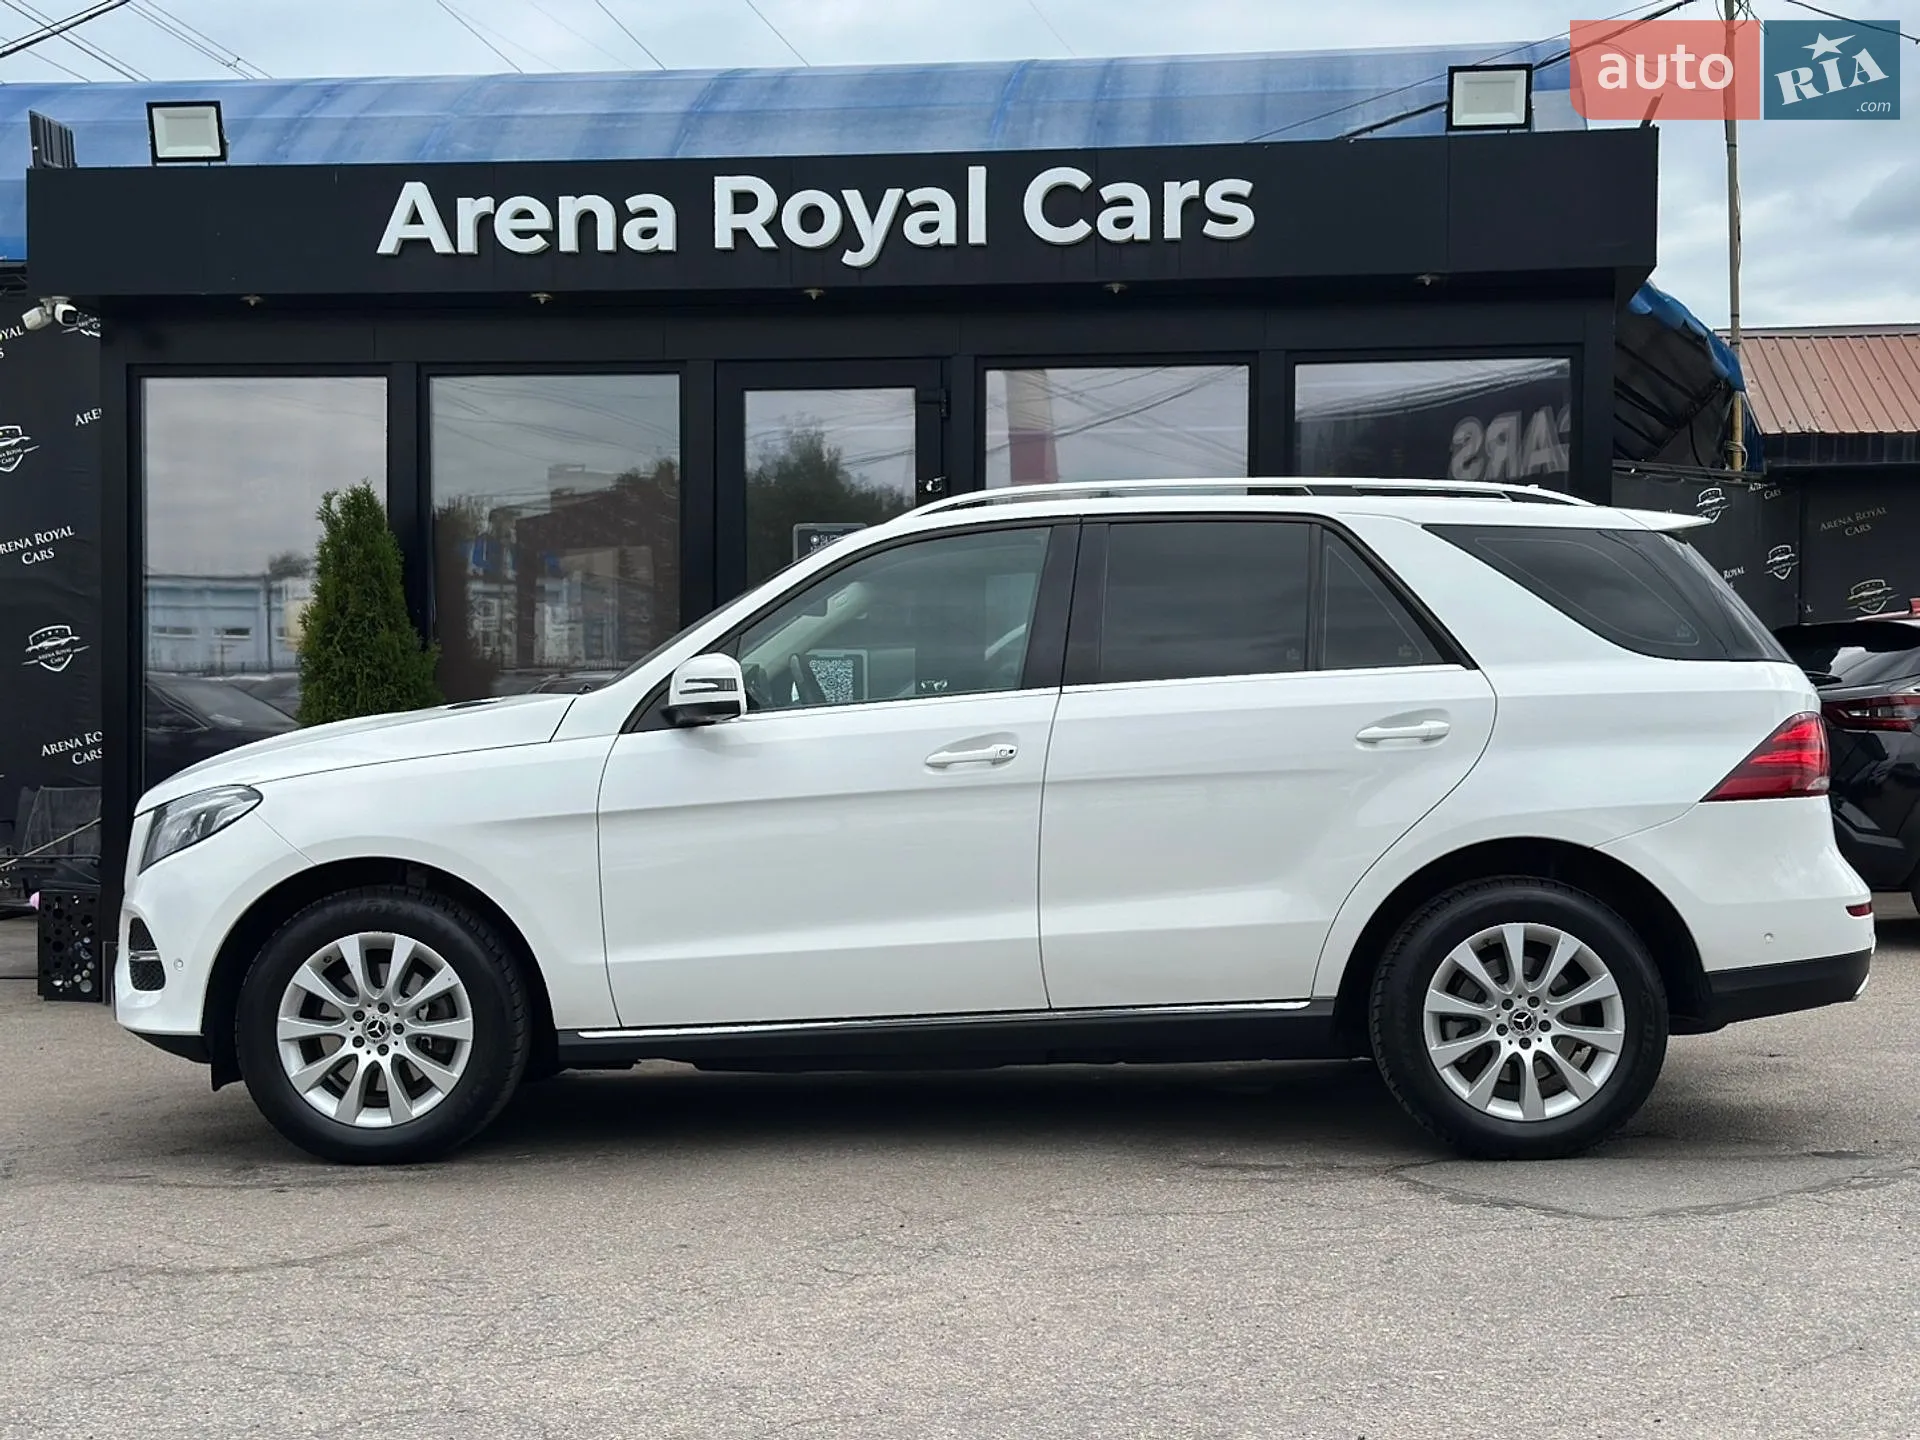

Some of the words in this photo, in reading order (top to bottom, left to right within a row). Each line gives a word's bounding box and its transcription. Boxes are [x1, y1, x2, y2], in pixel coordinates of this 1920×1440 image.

[376, 181, 677, 255] Arena
[713, 166, 988, 268] Royal
[1023, 166, 1256, 246] Cars
[34, 525, 75, 545] ROYAL
[21, 547, 55, 565] CARS
[41, 738, 83, 757] ARENA
